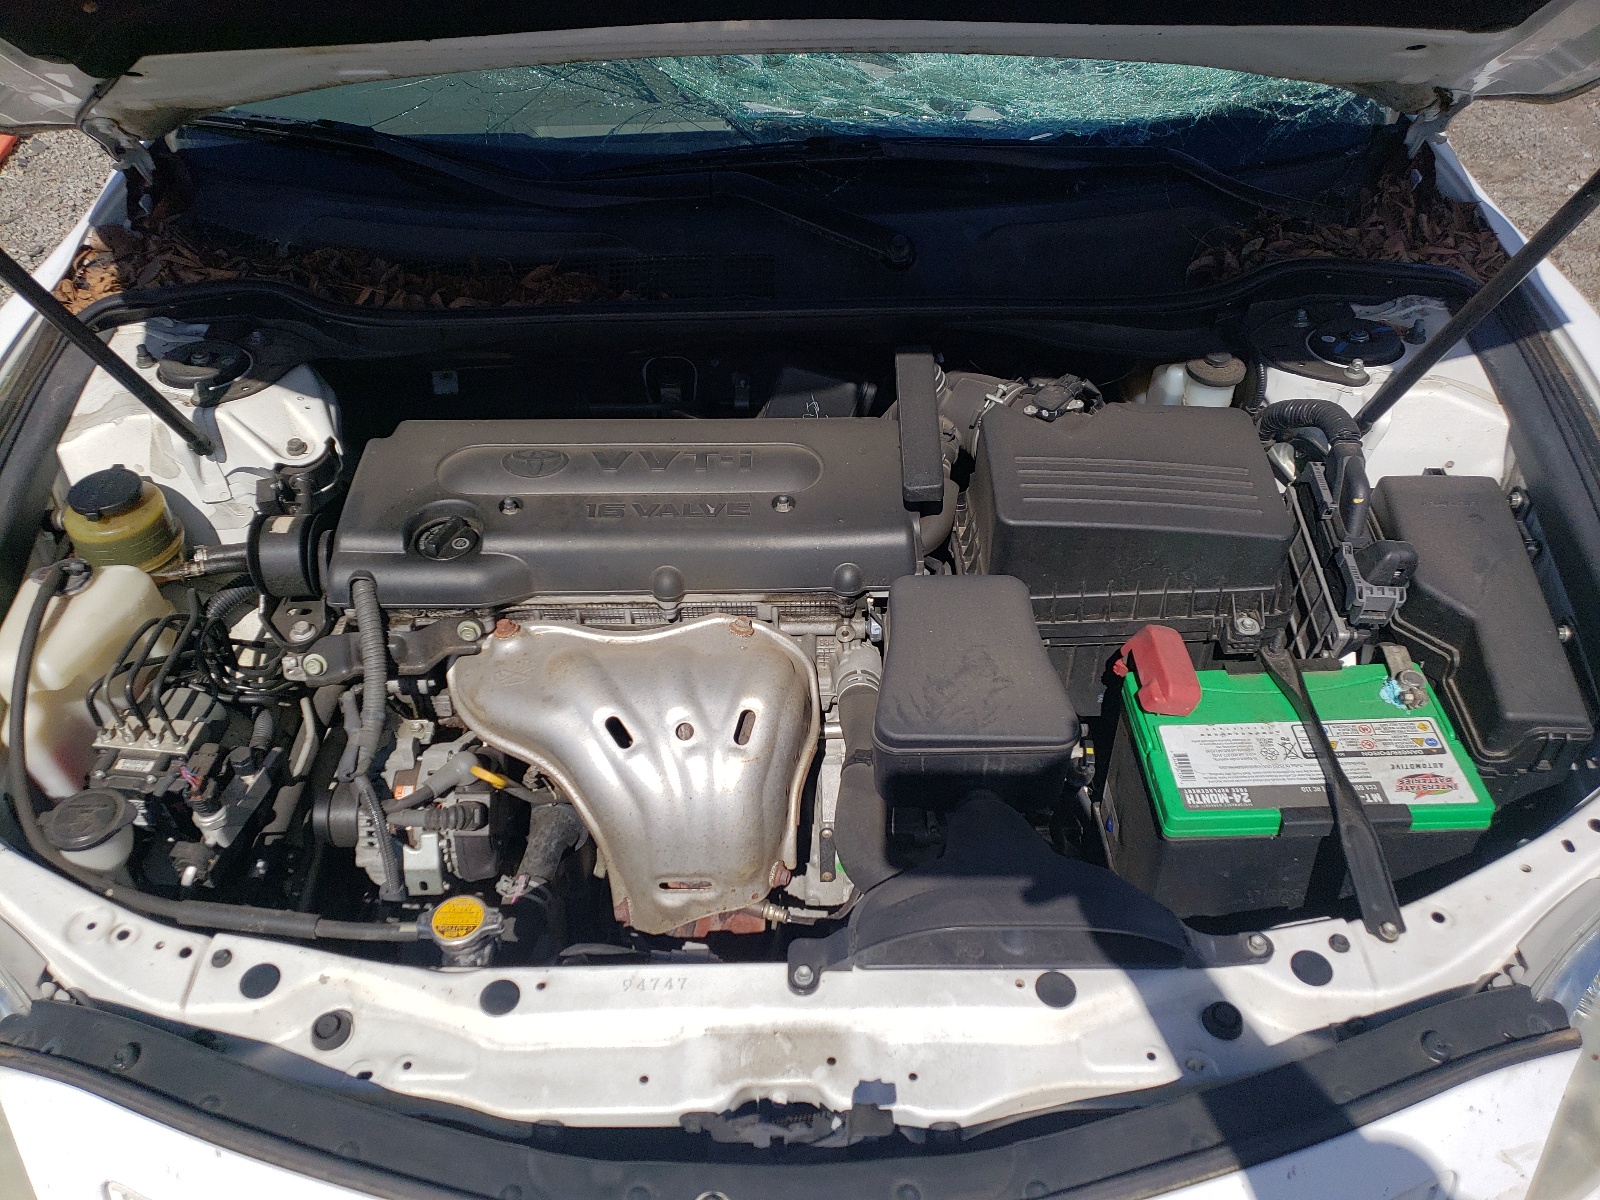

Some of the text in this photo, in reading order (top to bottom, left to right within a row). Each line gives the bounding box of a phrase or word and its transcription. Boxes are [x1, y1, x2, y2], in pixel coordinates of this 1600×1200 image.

[592, 450, 752, 471] VVT-i
[586, 502, 751, 518] 16 VALVE
[1390, 762, 1444, 770] AUTOMOTIVE
[1397, 783, 1458, 791] INTERSTATE
[1399, 777, 1453, 785] BATTERIES
[1185, 792, 1252, 804] 24-MONTH
[622, 976, 688, 992] 94747
